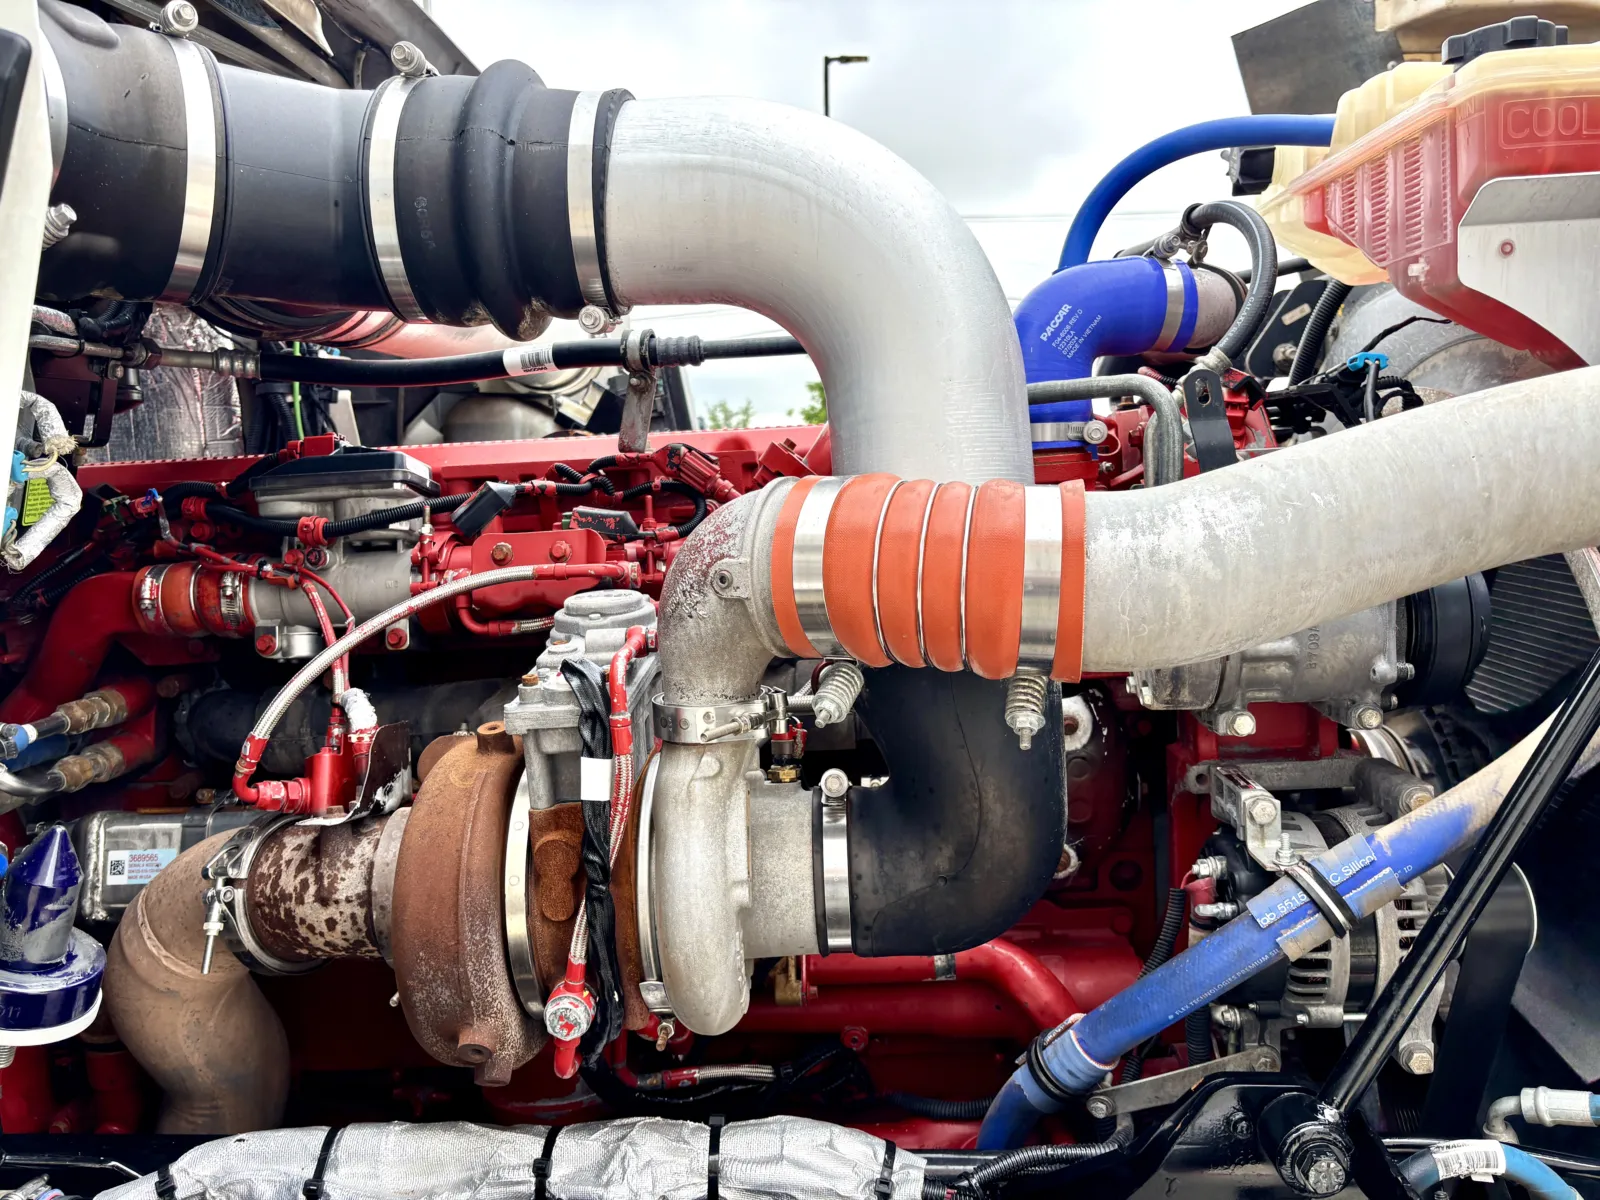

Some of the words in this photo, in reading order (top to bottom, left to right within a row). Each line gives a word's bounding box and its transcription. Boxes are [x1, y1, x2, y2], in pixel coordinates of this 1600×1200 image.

[1507, 101, 1600, 139] COOL
[1040, 303, 1072, 341] PACCAR
[1070, 313, 1081, 327] REV
[1235, 296, 1254, 326] GALAXY
[1066, 342, 1080, 358] MADE
[1082, 314, 1102, 338] VIETNAM
[129, 854, 159, 862] 3689565
[1277, 891, 1307, 914] 5515
[1175, 1004, 1190, 1016] FLEX
[1189, 975, 1238, 1007] TECHNOLOGIES
[1236, 954, 1270, 977] PREMIUM
